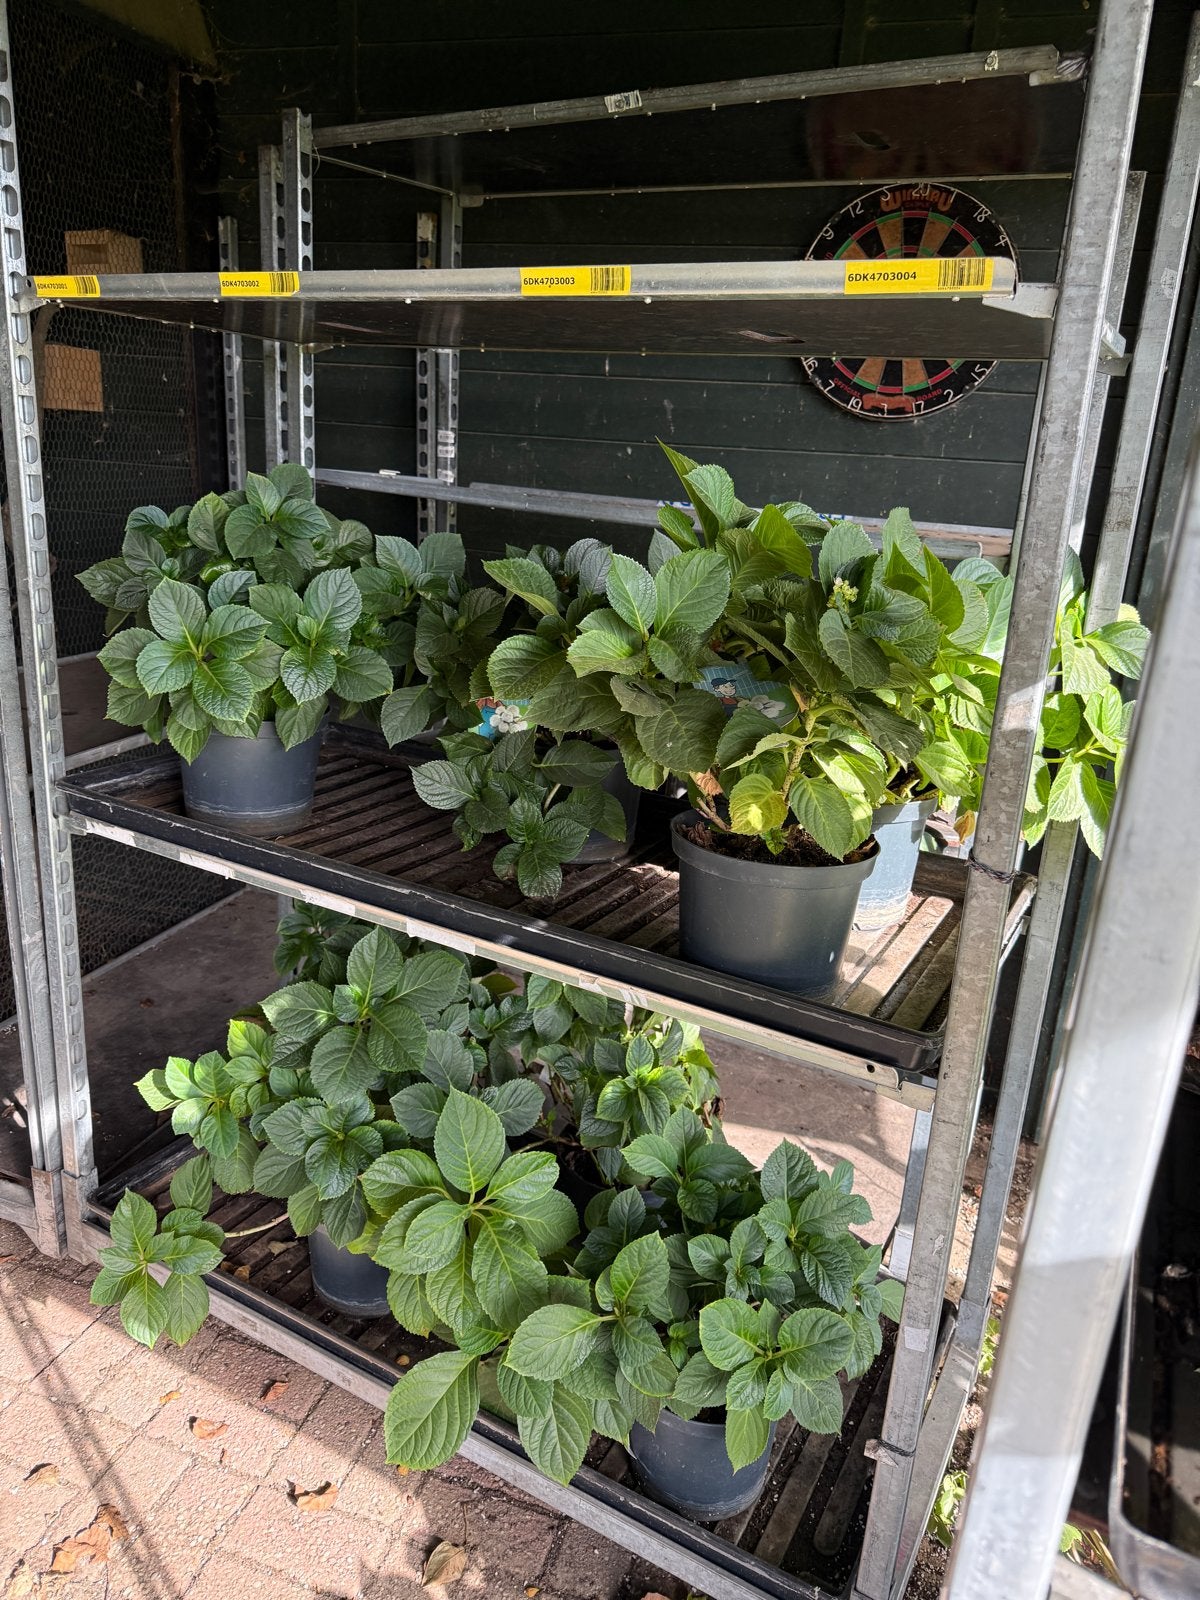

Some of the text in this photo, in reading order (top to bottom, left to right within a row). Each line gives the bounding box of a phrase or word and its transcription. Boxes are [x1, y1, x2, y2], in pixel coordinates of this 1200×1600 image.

[848, 200, 864, 218] 12
[972, 205, 992, 223] 18
[822, 225, 834, 240] 9
[994, 234, 1008, 248] 4
[523, 277, 575, 286] 6DK4703003
[847, 271, 917, 282] 6DK4703004
[221, 280, 260, 288] 6DK4703002
[971, 364, 988, 381] 15
[824, 379, 835, 393] 7
[943, 389, 954, 403] 2
[847, 396, 862, 412] 19
[912, 400, 925, 415] 17
